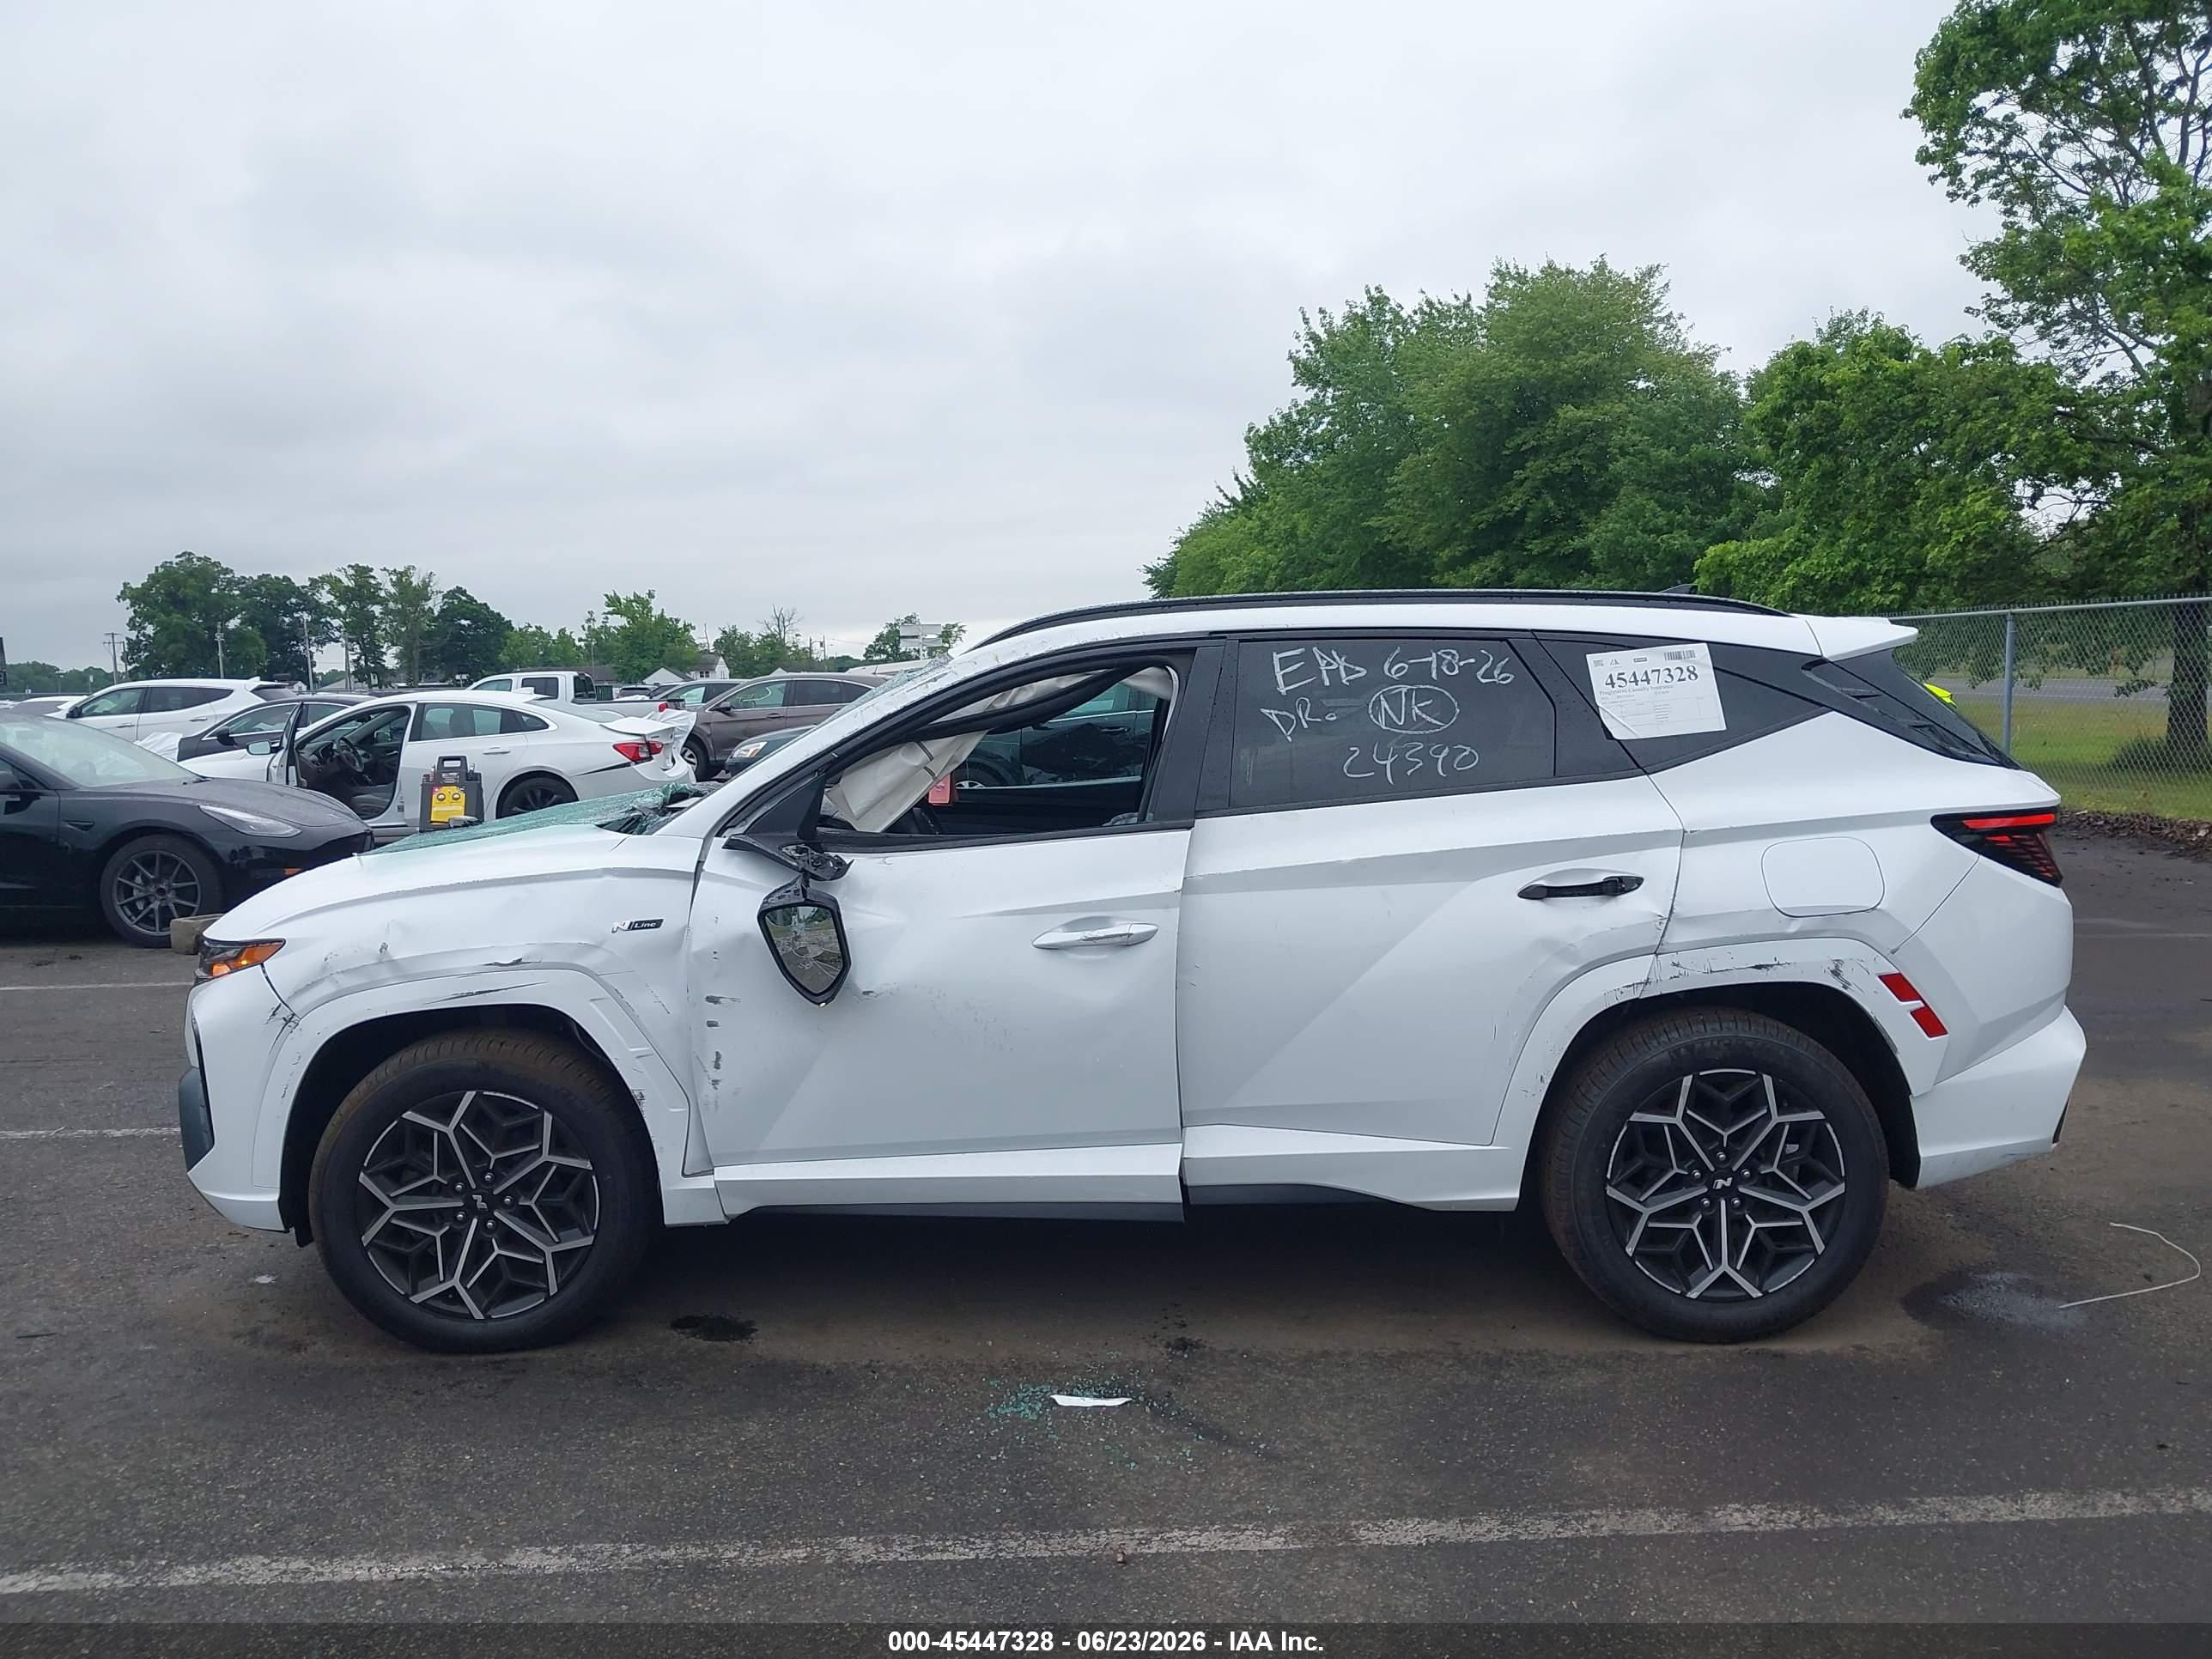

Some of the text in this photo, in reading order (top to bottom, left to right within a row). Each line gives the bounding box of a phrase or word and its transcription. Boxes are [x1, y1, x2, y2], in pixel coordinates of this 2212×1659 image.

[1383, 647, 1515, 685] 6-18-26
[1605, 665, 1698, 689] 45447328
[1376, 687, 1446, 730] NK
